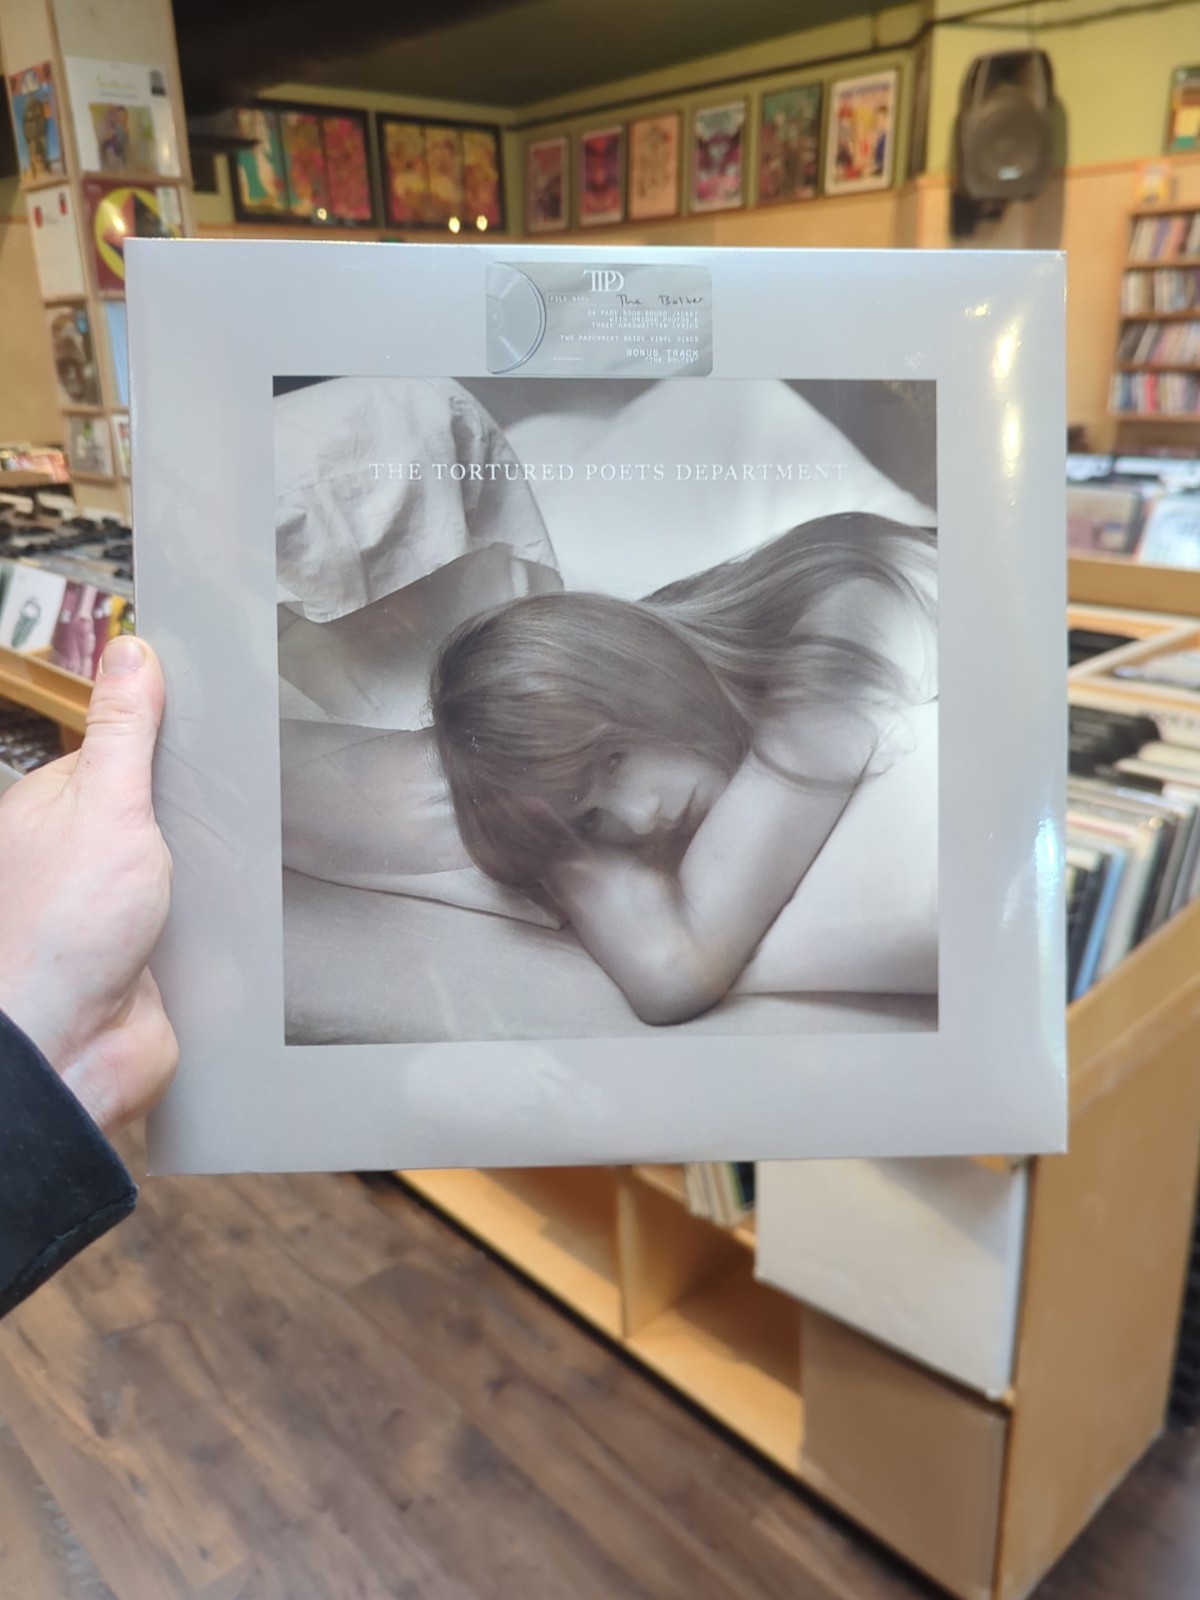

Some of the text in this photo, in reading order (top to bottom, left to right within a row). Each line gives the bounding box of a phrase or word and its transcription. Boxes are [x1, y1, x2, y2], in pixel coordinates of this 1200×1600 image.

[616, 293, 643, 307] The
[626, 348, 699, 358] BONUS TRACK
[369, 463, 848, 481] THE TORTURED POETS DEPARTMENT
